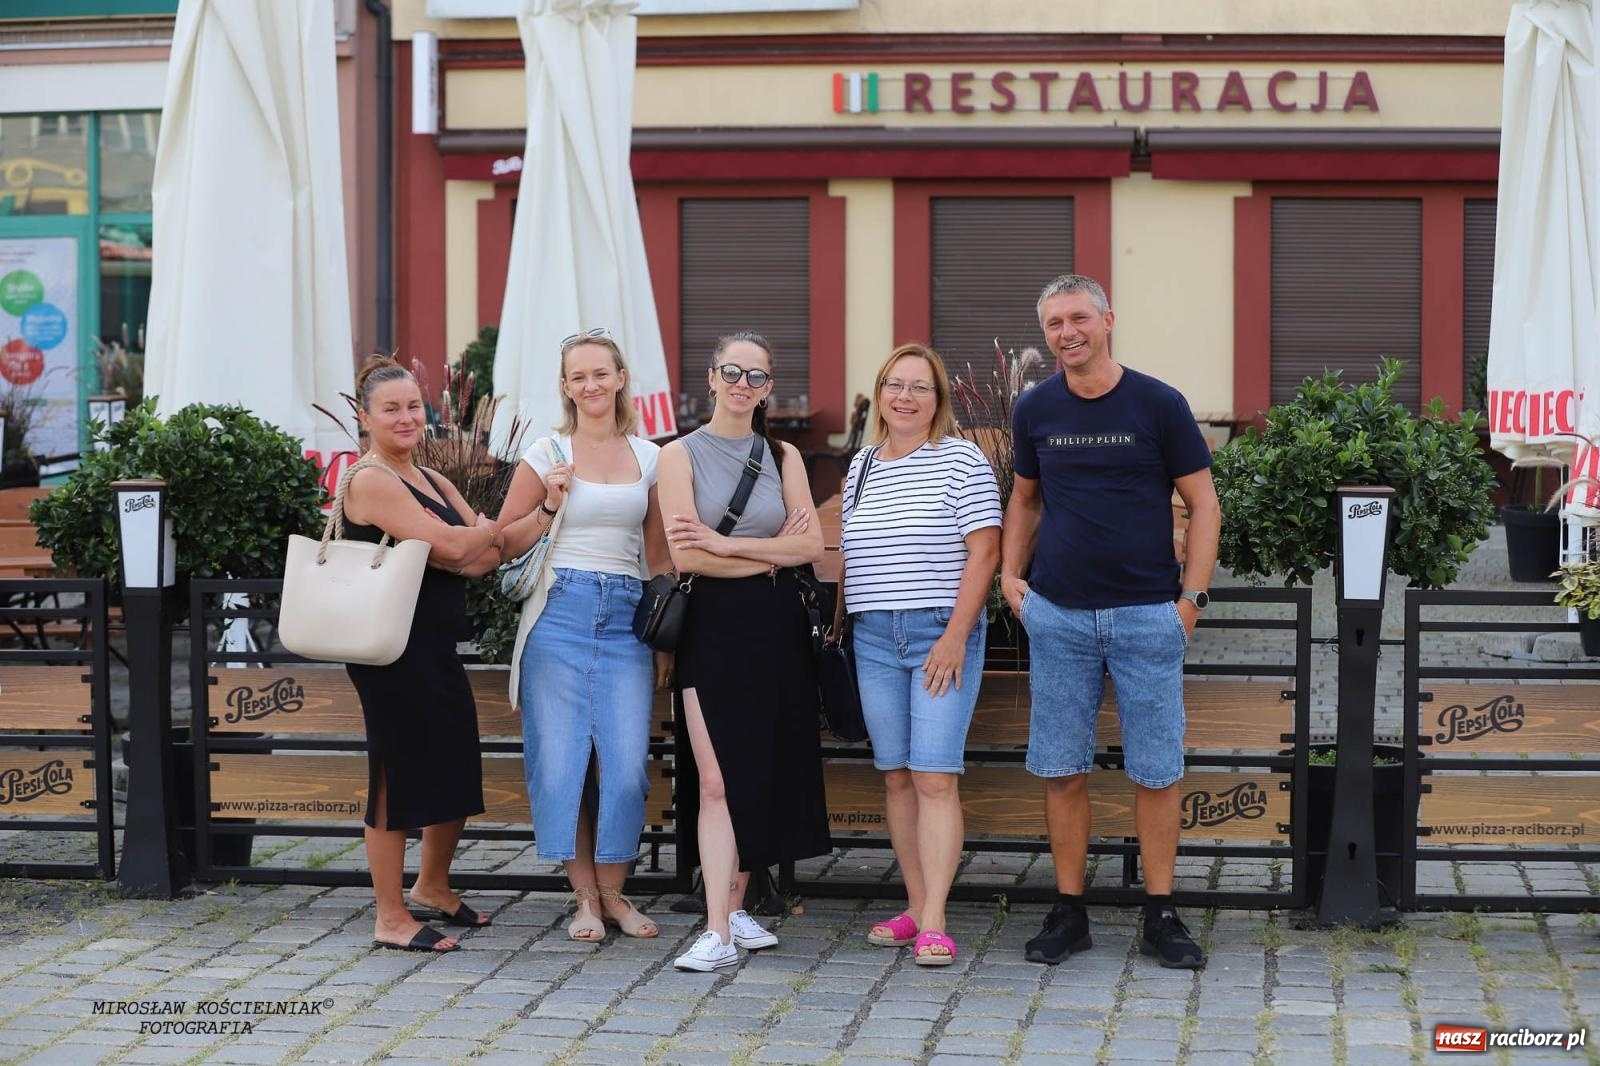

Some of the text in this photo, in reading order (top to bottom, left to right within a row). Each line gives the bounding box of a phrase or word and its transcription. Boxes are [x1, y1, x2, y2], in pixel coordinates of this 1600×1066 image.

[904, 70, 1380, 113] RESTAURACJA
[1050, 435, 1131, 446] PHILIPP PLEIN
[219, 799, 361, 813] www.pizza-raciborz.pl
[1430, 823, 1585, 837] www.pizza-raciborz.pl
